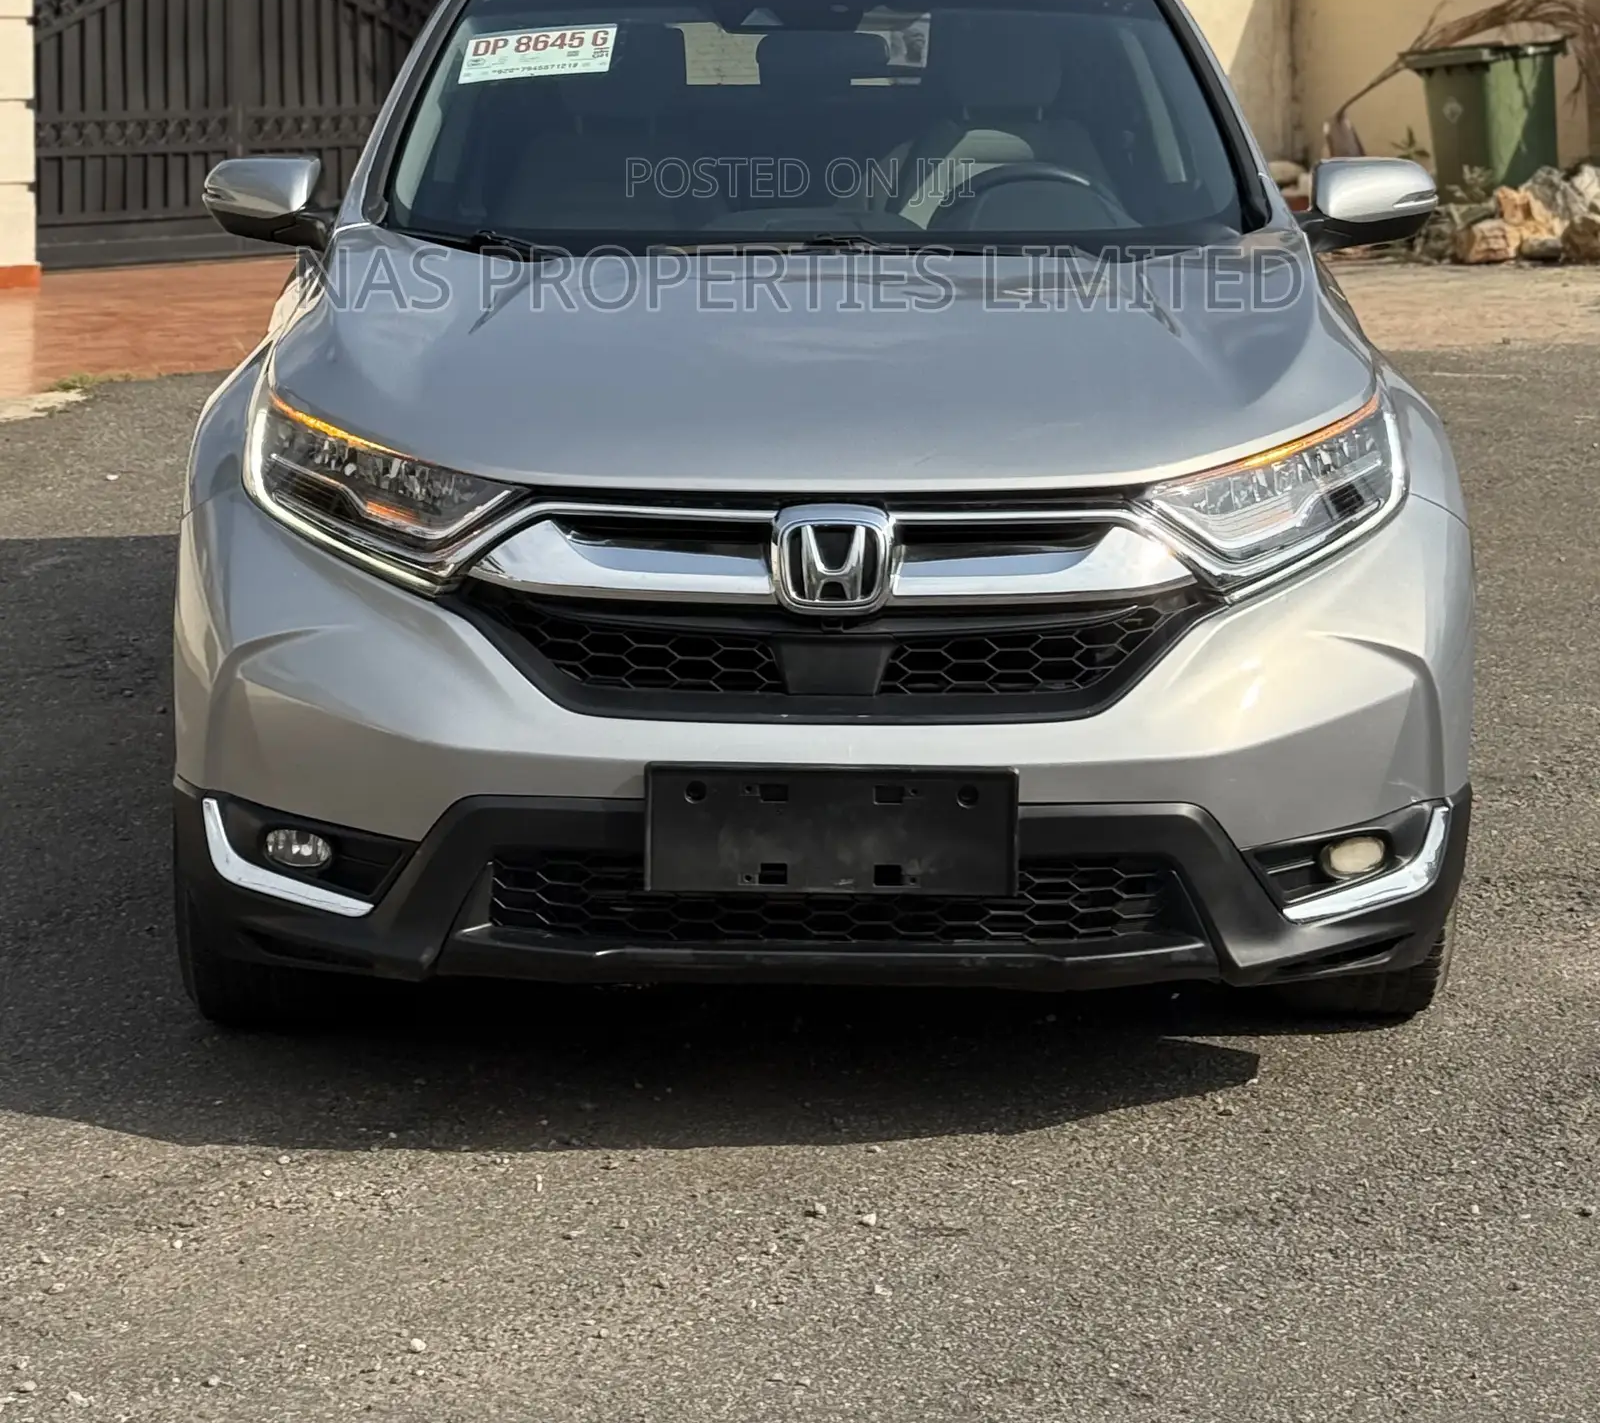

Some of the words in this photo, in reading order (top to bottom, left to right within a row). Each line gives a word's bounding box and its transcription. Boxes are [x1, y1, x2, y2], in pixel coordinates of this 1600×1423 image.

[473, 38, 508, 56] DP
[515, 32, 585, 52] 8645
[592, 31, 609, 46] G
